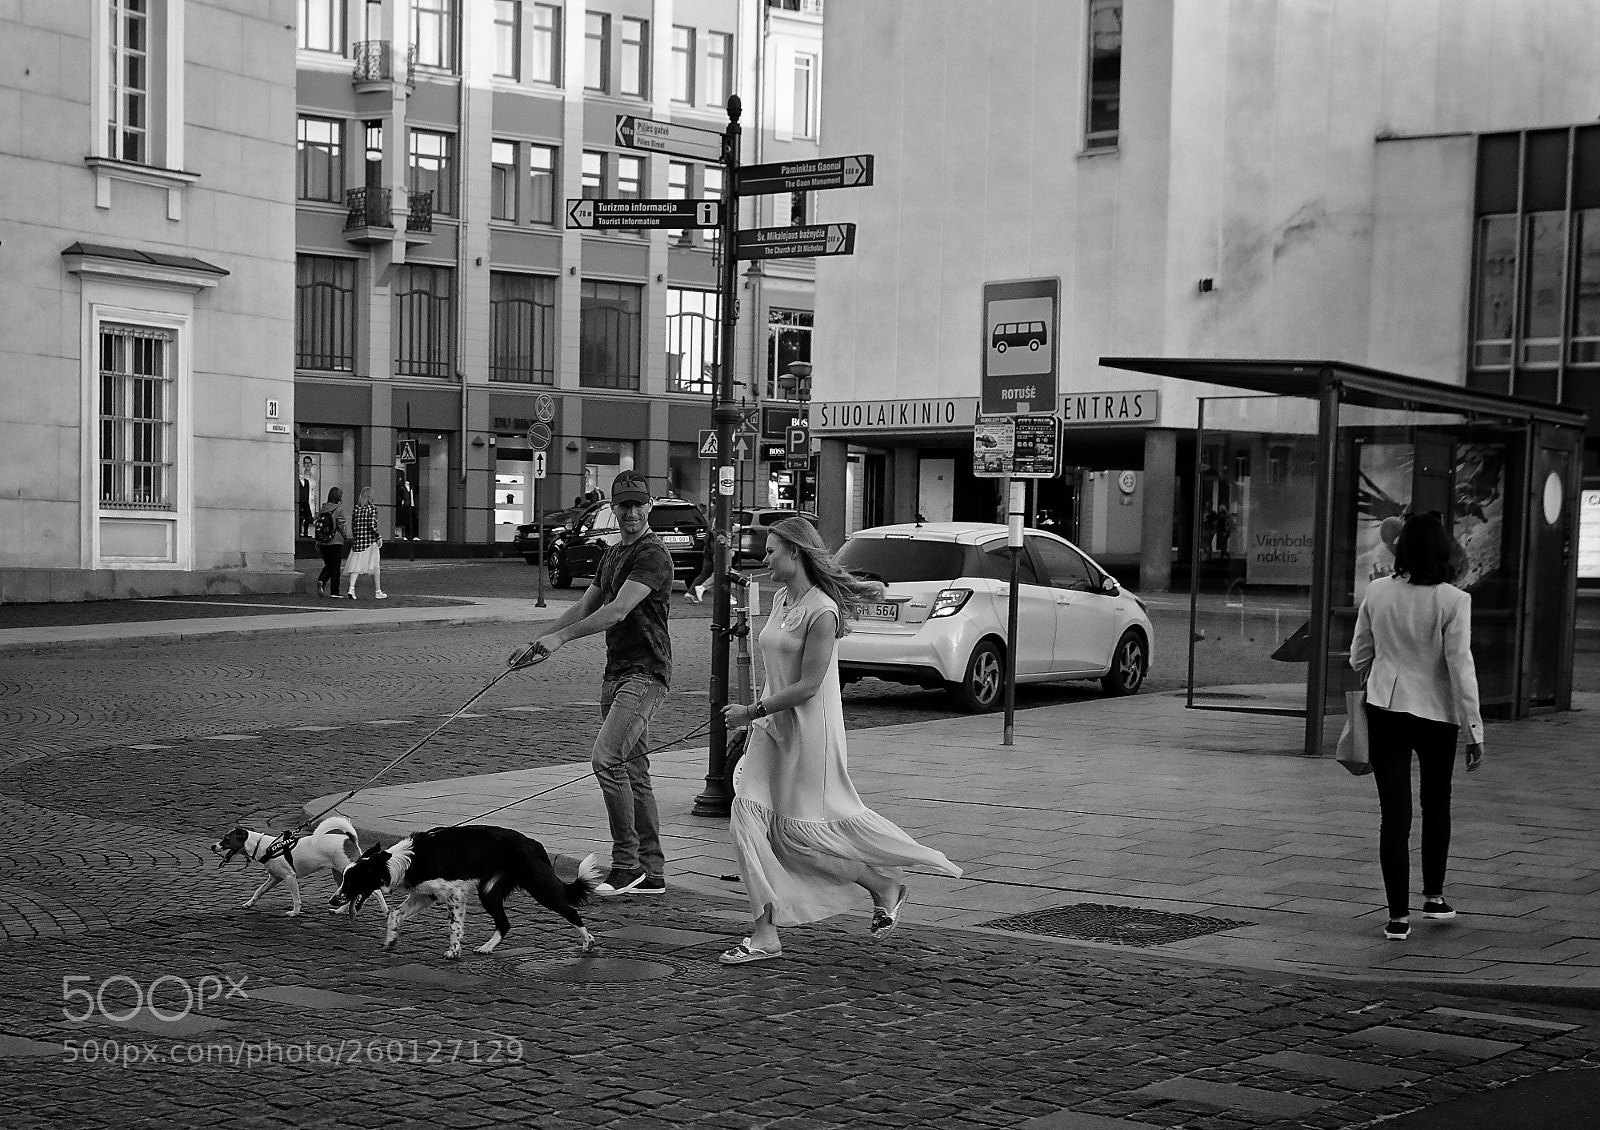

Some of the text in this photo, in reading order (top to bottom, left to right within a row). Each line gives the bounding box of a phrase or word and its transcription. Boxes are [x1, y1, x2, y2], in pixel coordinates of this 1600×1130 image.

[781, 160, 841, 175] Paminklas Gaonui
[785, 176, 841, 188] The Gaon Monument
[598, 202, 678, 213] Turizmo informacija
[598, 217, 660, 226] Tourist Information
[764, 246, 774, 255] The
[773, 245, 791, 254] Church
[1001, 385, 1037, 400] ROTUŠĖ
[269, 401, 277, 416] 31
[1064, 394, 1143, 420] ENTRAS
[821, 402, 955, 427] ŠIUOLAIKINIO
[790, 430, 805, 453] P
[769, 447, 785, 455] BOSS
[1257, 549, 1297, 563] naktis
[876, 605, 895, 616] 564
